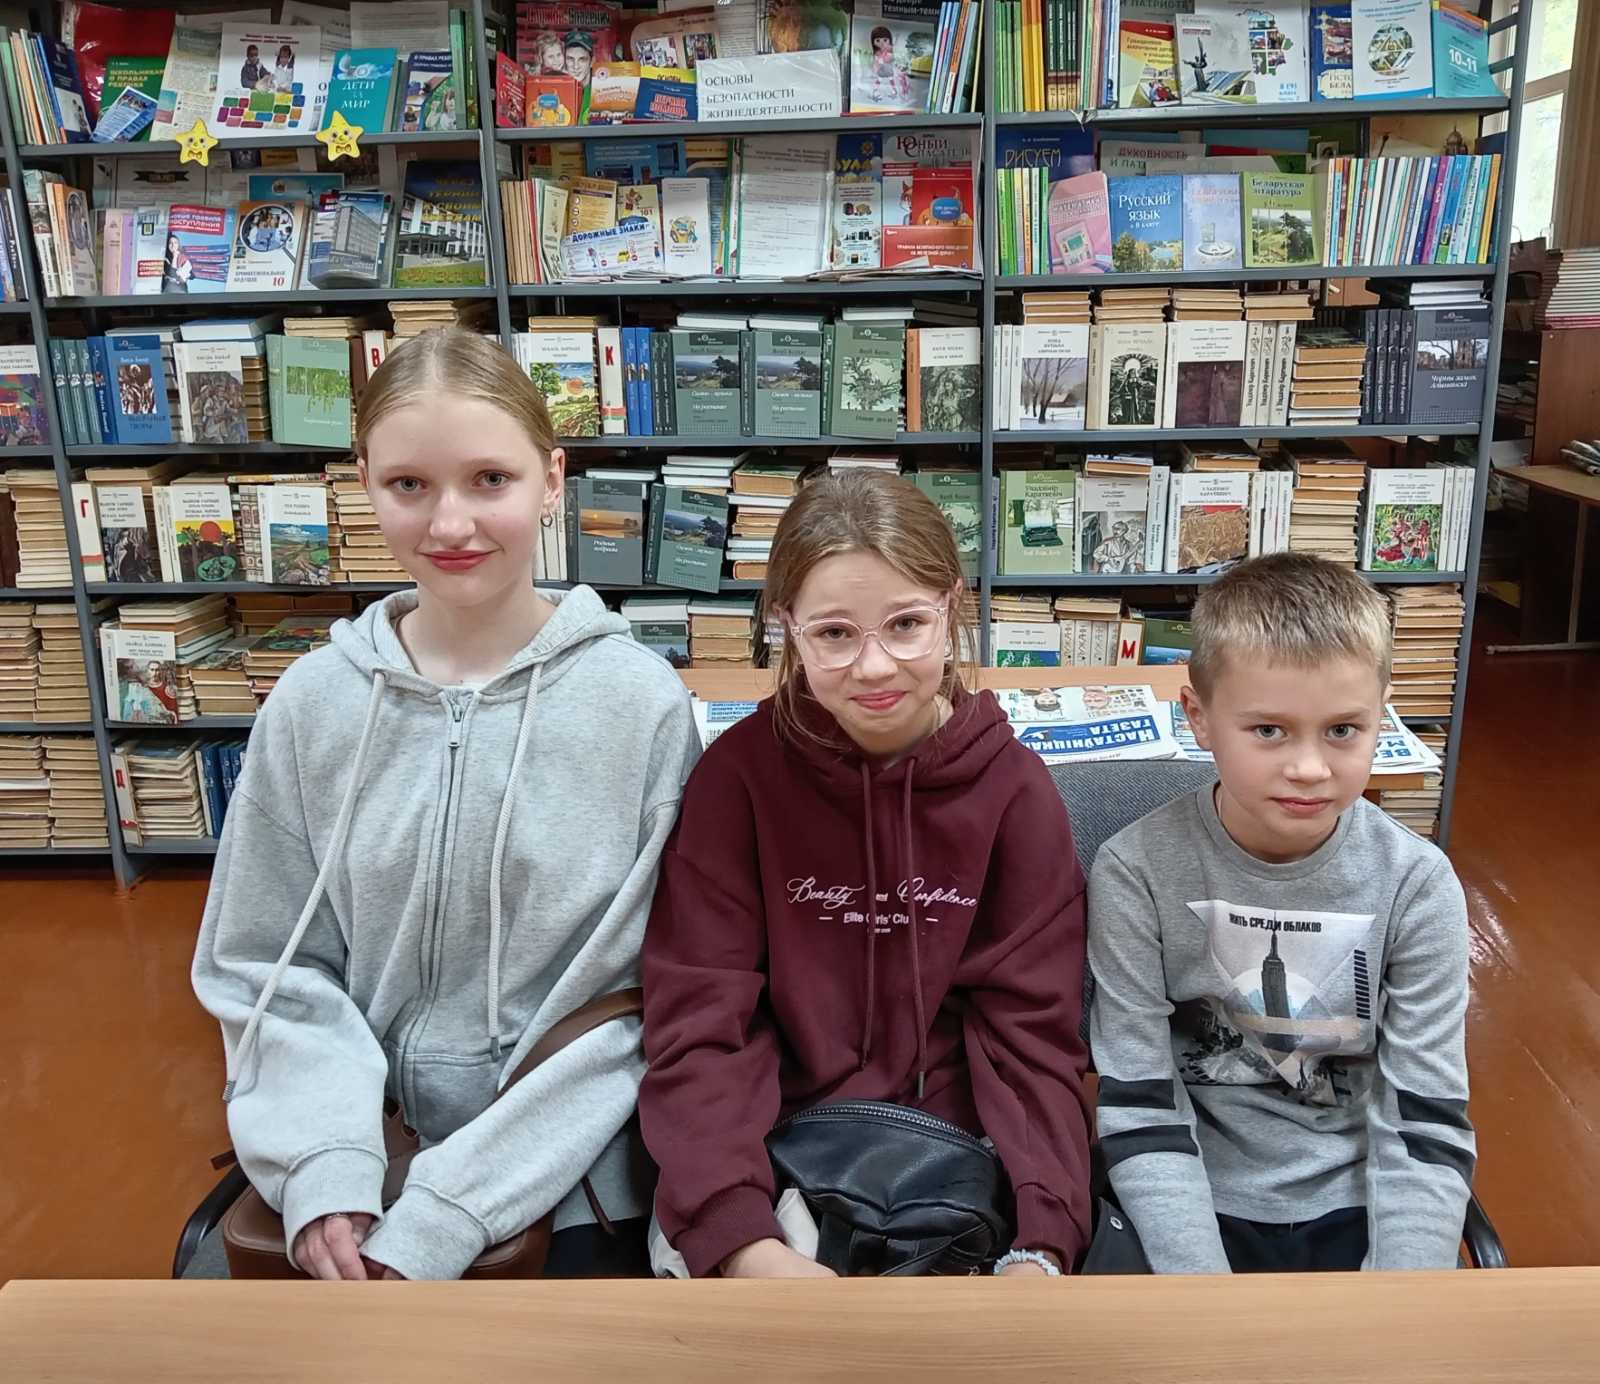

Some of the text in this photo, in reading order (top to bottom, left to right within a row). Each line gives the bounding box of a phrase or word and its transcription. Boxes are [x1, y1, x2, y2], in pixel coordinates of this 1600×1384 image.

[342, 80, 375, 91] ДЕТИ
[704, 74, 754, 88] ОСНОВЫ
[341, 99, 371, 110] МИР
[705, 88, 795, 104] БЕЗОПАСНОСТИ
[704, 102, 833, 120] ЖИЗНЕДЕЯТЕЛЬНОСТИ
[1118, 146, 1188, 160] ДУХОВНОСТЬ
[1118, 191, 1172, 211] Русский
[571, 221, 647, 243] ДОРОЖНЫЕ ЗНАКИ
[272, 275, 286, 287] 10
[605, 345, 614, 366] К
[1121, 639, 1137, 659] М
[1089, 718, 1151, 735] ГАЗЕТА
[787, 876, 866, 910] Beauty
[896, 876, 979, 908] Confidence
[843, 911, 909, 925] Elite rls' Clu
[1229, 912, 1322, 933] ЖИТЬ СРЕДИ ОБЛАКОВ
